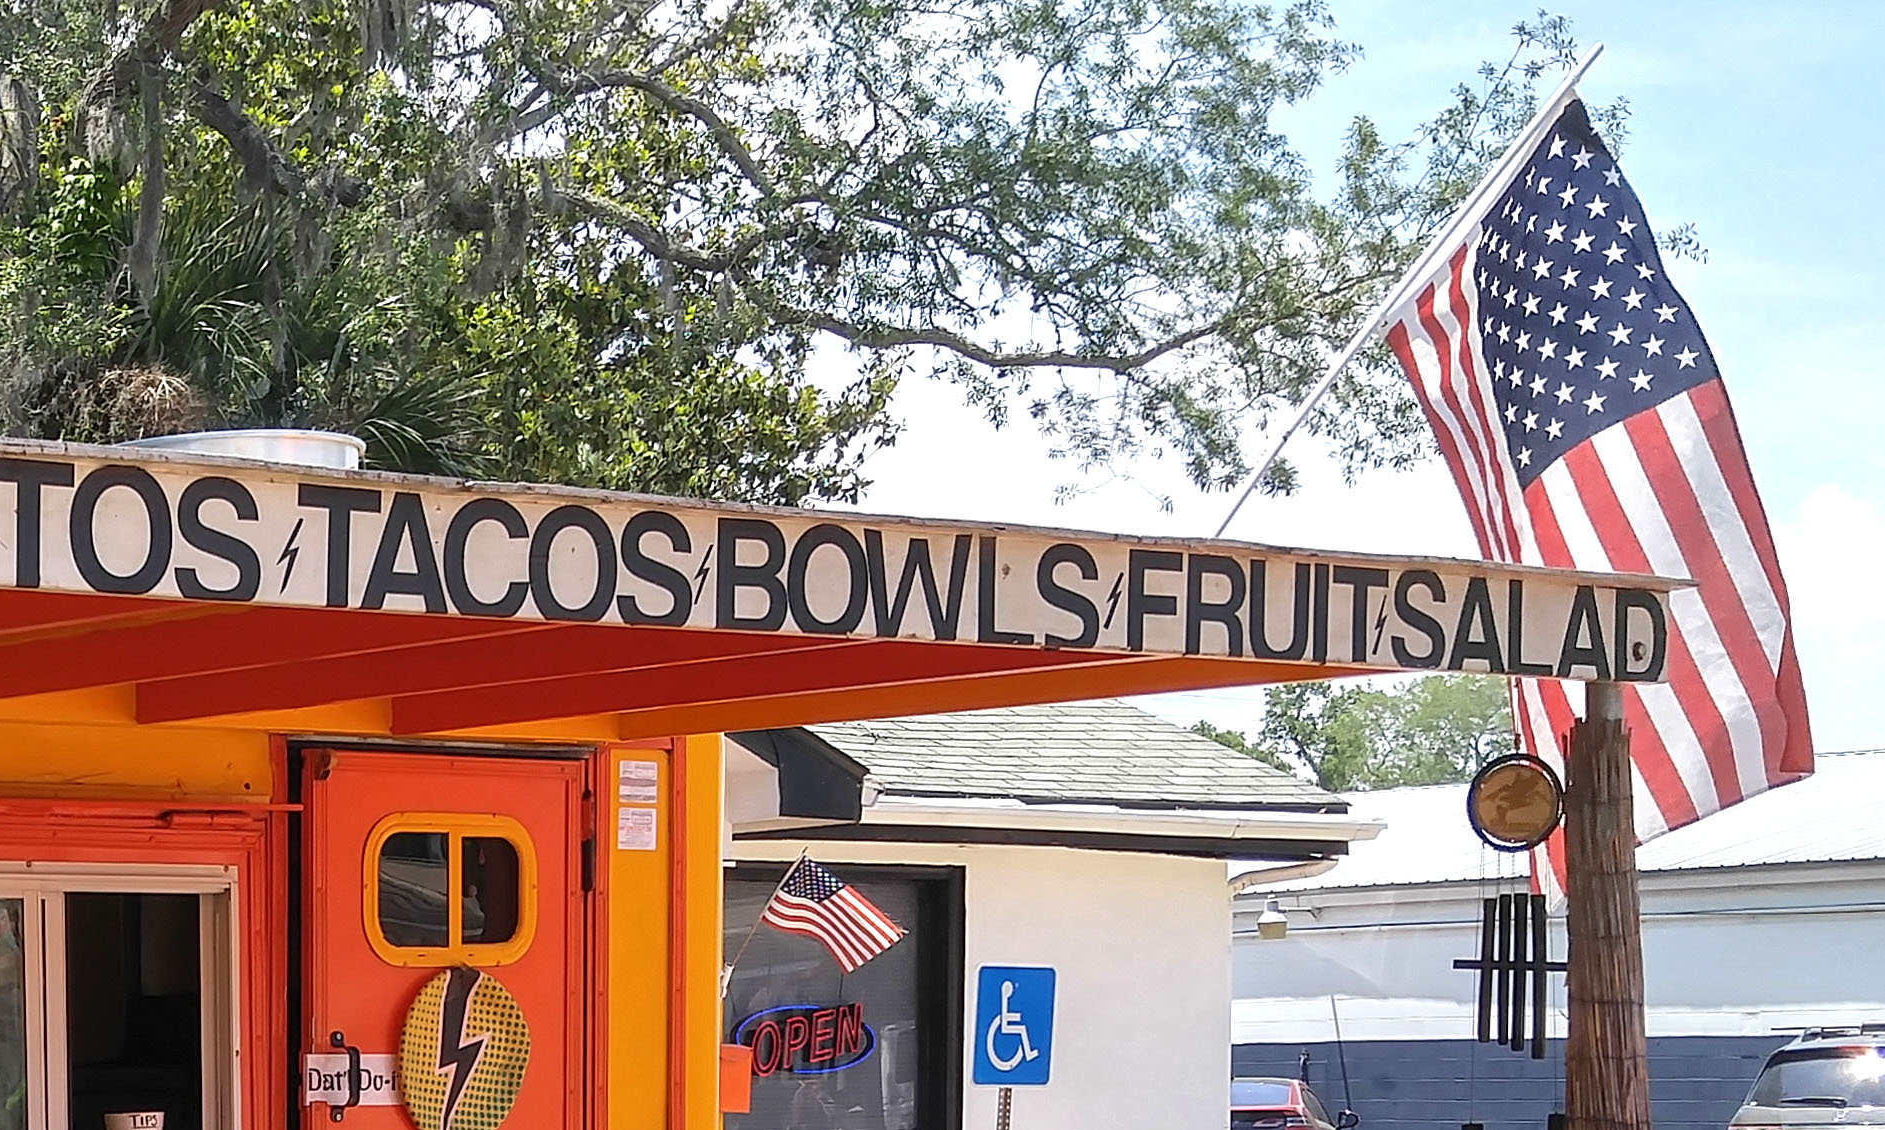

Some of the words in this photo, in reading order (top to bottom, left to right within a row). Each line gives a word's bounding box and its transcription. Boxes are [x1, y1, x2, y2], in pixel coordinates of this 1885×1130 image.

[298, 483, 693, 627] TACOS
[716, 516, 1099, 649] BOWLS
[1128, 549, 1389, 666] FRUIT
[1391, 569, 1668, 683] SALAD
[751, 1002, 863, 1077] OPEN
[308, 1068, 351, 1091] Dat'
[360, 1069, 396, 1091] Do-i
[128, 1114, 158, 1127] TIPS
